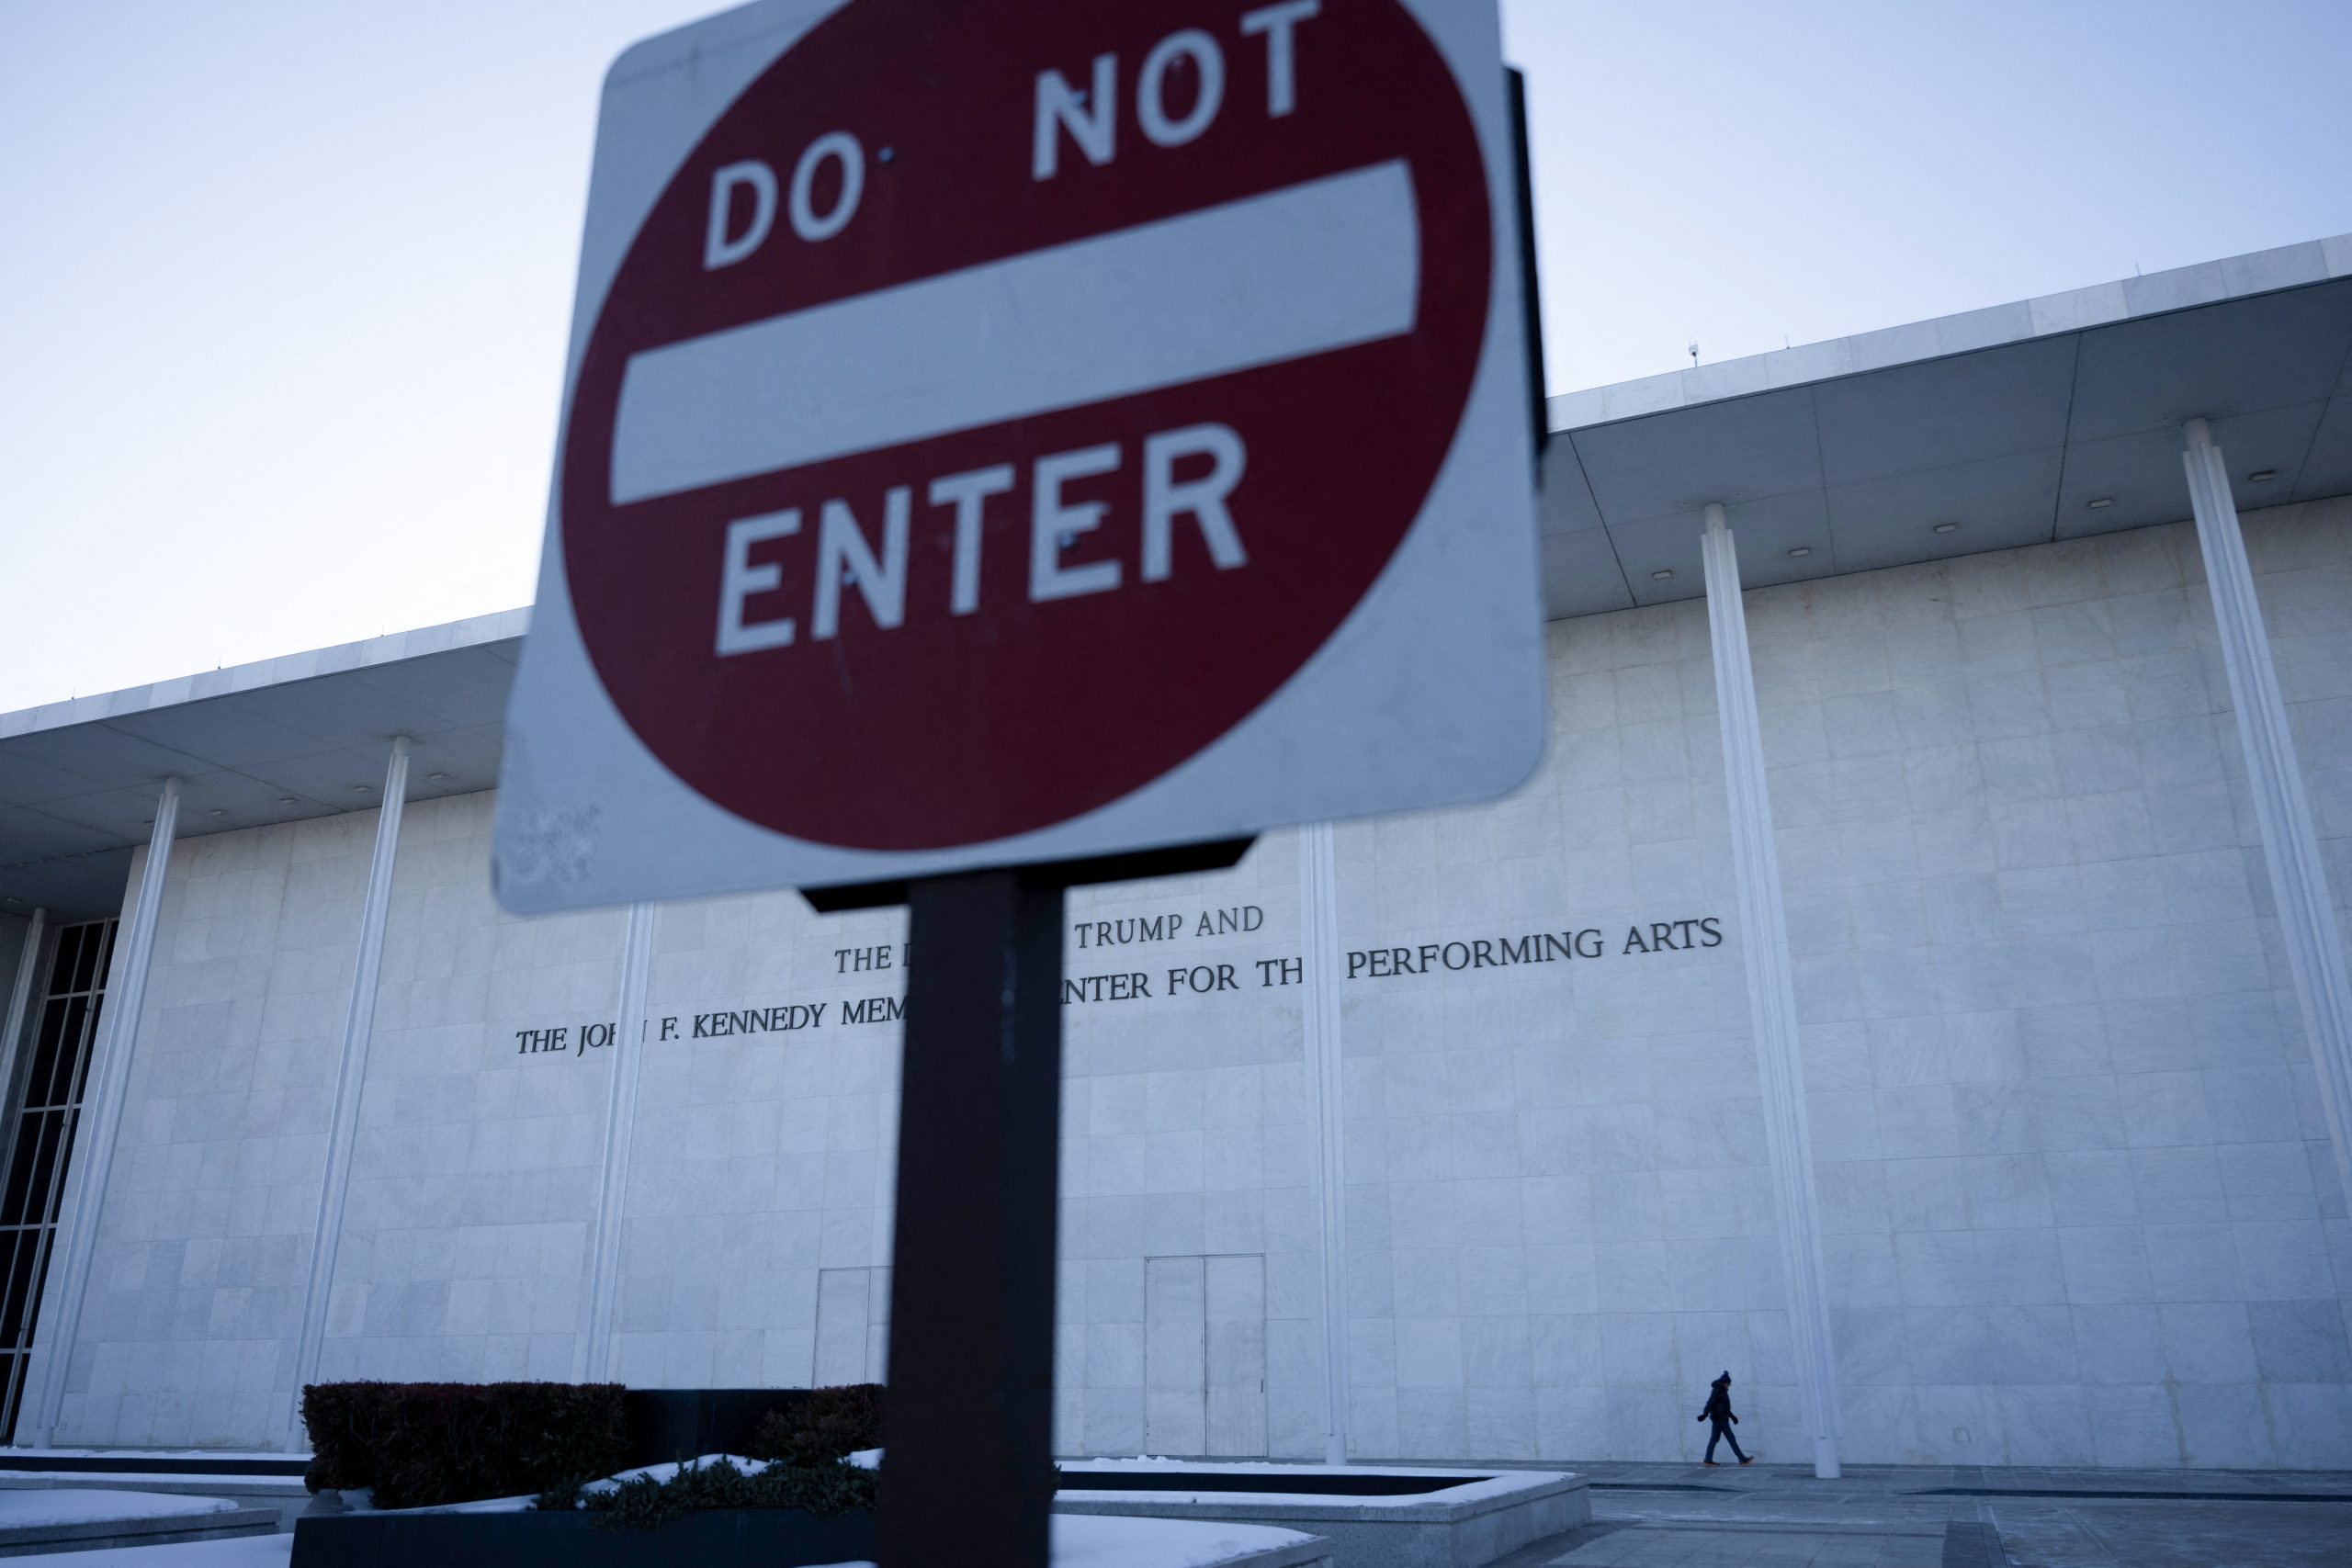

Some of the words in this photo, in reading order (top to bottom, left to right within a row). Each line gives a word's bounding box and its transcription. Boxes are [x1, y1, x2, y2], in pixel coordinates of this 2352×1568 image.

[704, 130, 865, 270] DO
[1032, 0, 1321, 182] NOT
[715, 422, 1248, 658] ENTER
[515, 1027, 568, 1054] THE
[659, 1017, 681, 1042] F.
[692, 1003, 827, 1039] KENNEDY
[1058, 972, 1152, 1005] NTER
[1167, 964, 1239, 996] FOR
[1256, 957, 1303, 987] TH
[1346, 929, 1605, 979] PERFORMING
[1622, 917, 1723, 955] ARTS
[833, 944, 892, 974] THE
[1074, 913, 1183, 949] TRUMP
[1195, 905, 1264, 937] AND
